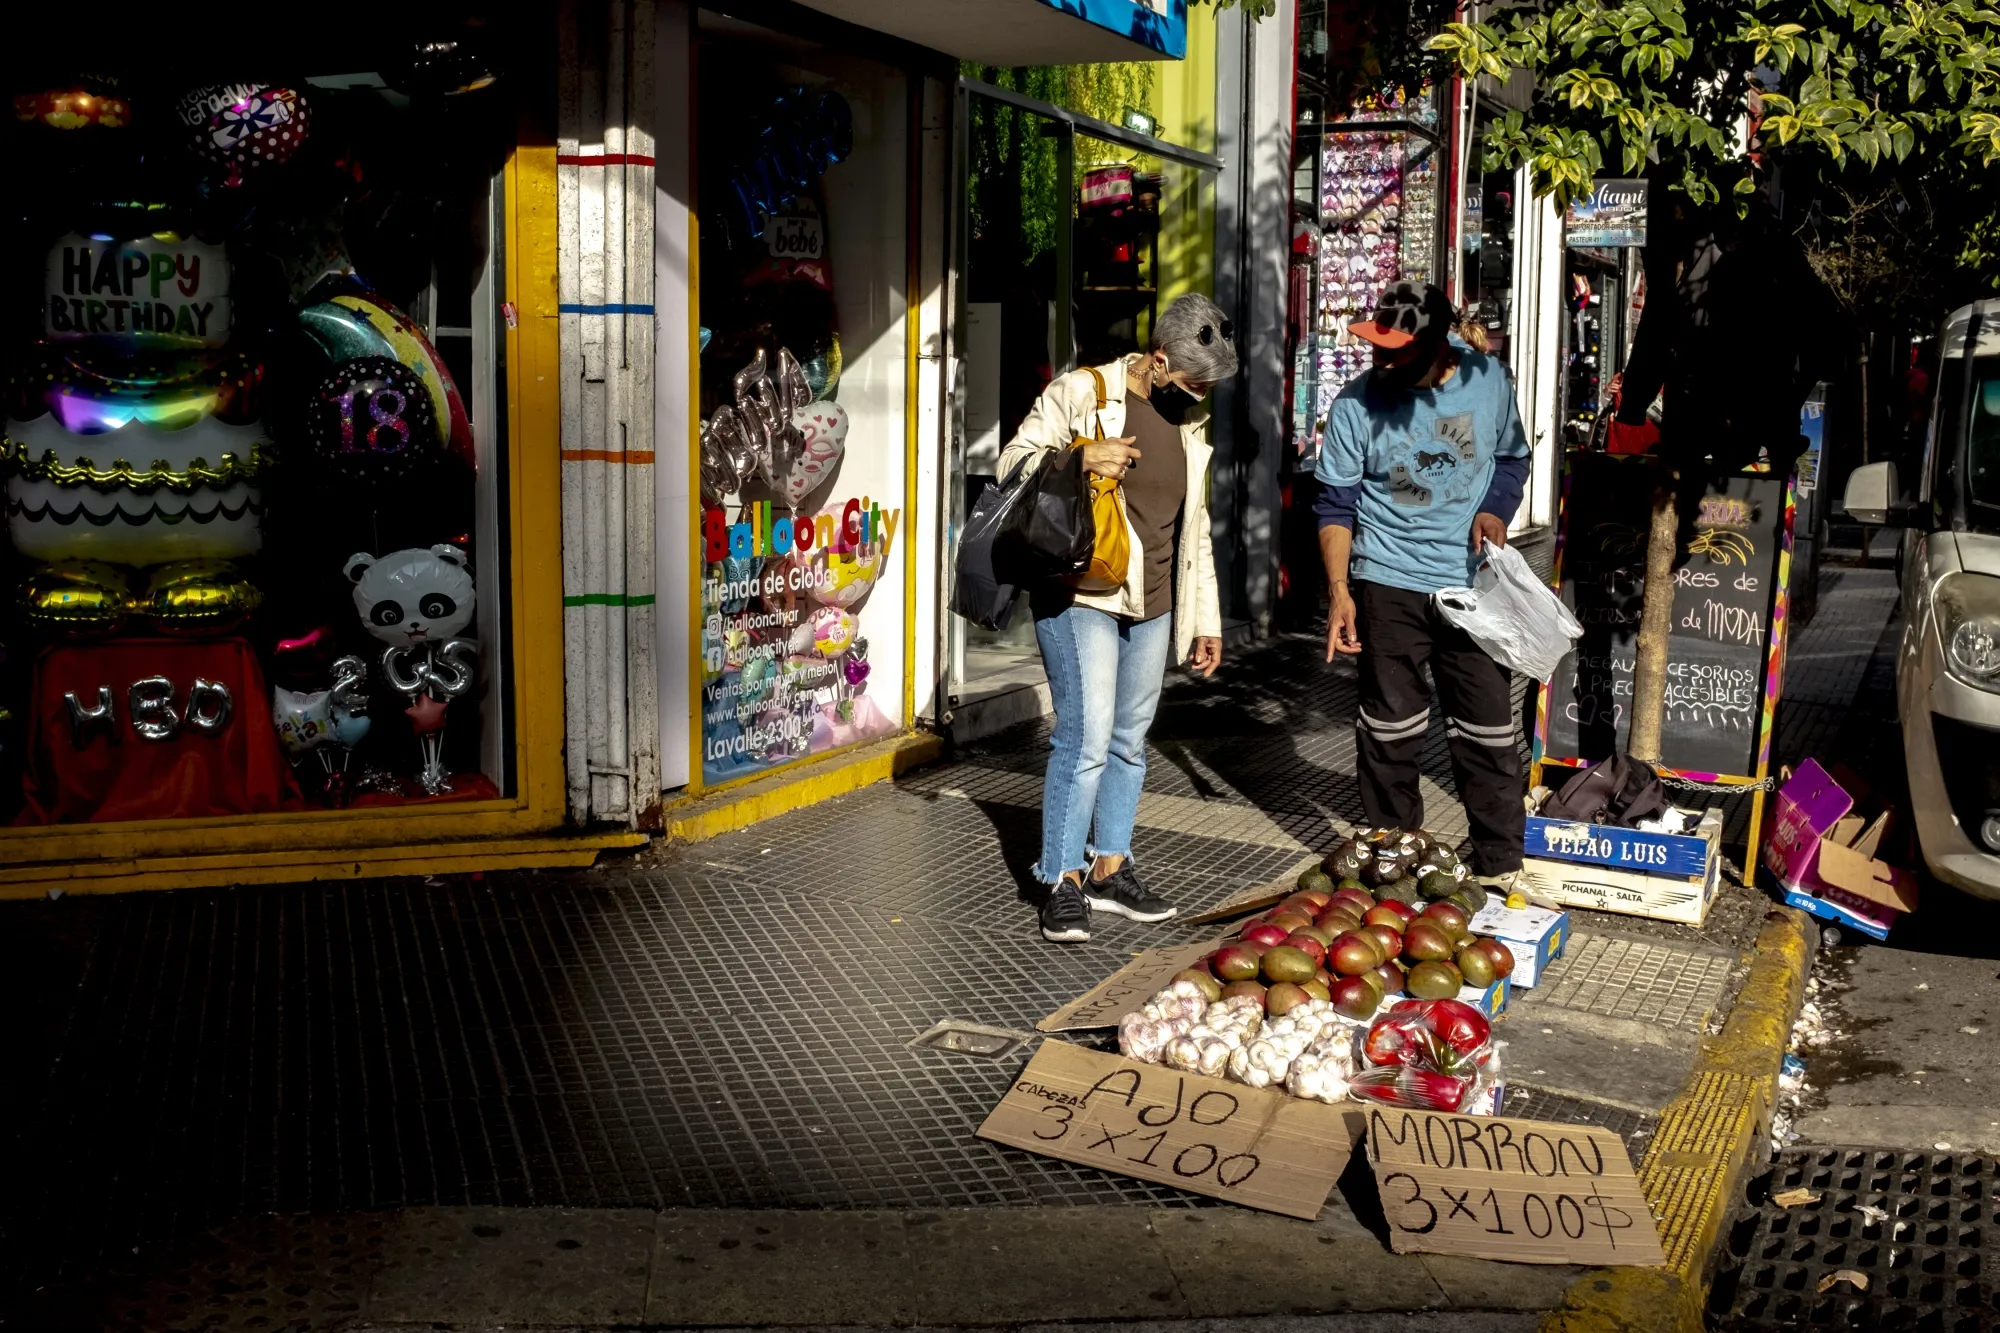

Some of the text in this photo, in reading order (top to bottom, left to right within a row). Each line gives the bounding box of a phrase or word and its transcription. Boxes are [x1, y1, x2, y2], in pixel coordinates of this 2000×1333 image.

[776, 226, 818, 253] bebé
[62, 246, 201, 298] HAPPY
[51, 297, 214, 338] BIRTHDAY
[330, 386, 412, 455] 18
[1441, 423, 1471, 450] DALE
[706, 495, 901, 562] Balloon City
[706, 565, 839, 603] Tienda de Globos
[1734, 572, 1758, 592] de
[1682, 607, 1701, 630] de
[708, 662, 837, 702] Ventas por mayor y menor
[1591, 674, 1633, 697] PREC
[1664, 682, 1753, 706] ACCESIBLES
[1667, 662, 1754, 683] CESORIOS
[63, 674, 233, 741] HBD
[708, 717, 801, 761] Lavalle 2300
[1620, 841, 1668, 865] LUIS
[1562, 883, 1643, 902] PICHANAL SALTA
[1081, 1068, 1240, 1128] AJO
[1371, 1108, 1604, 1178] MORRON
